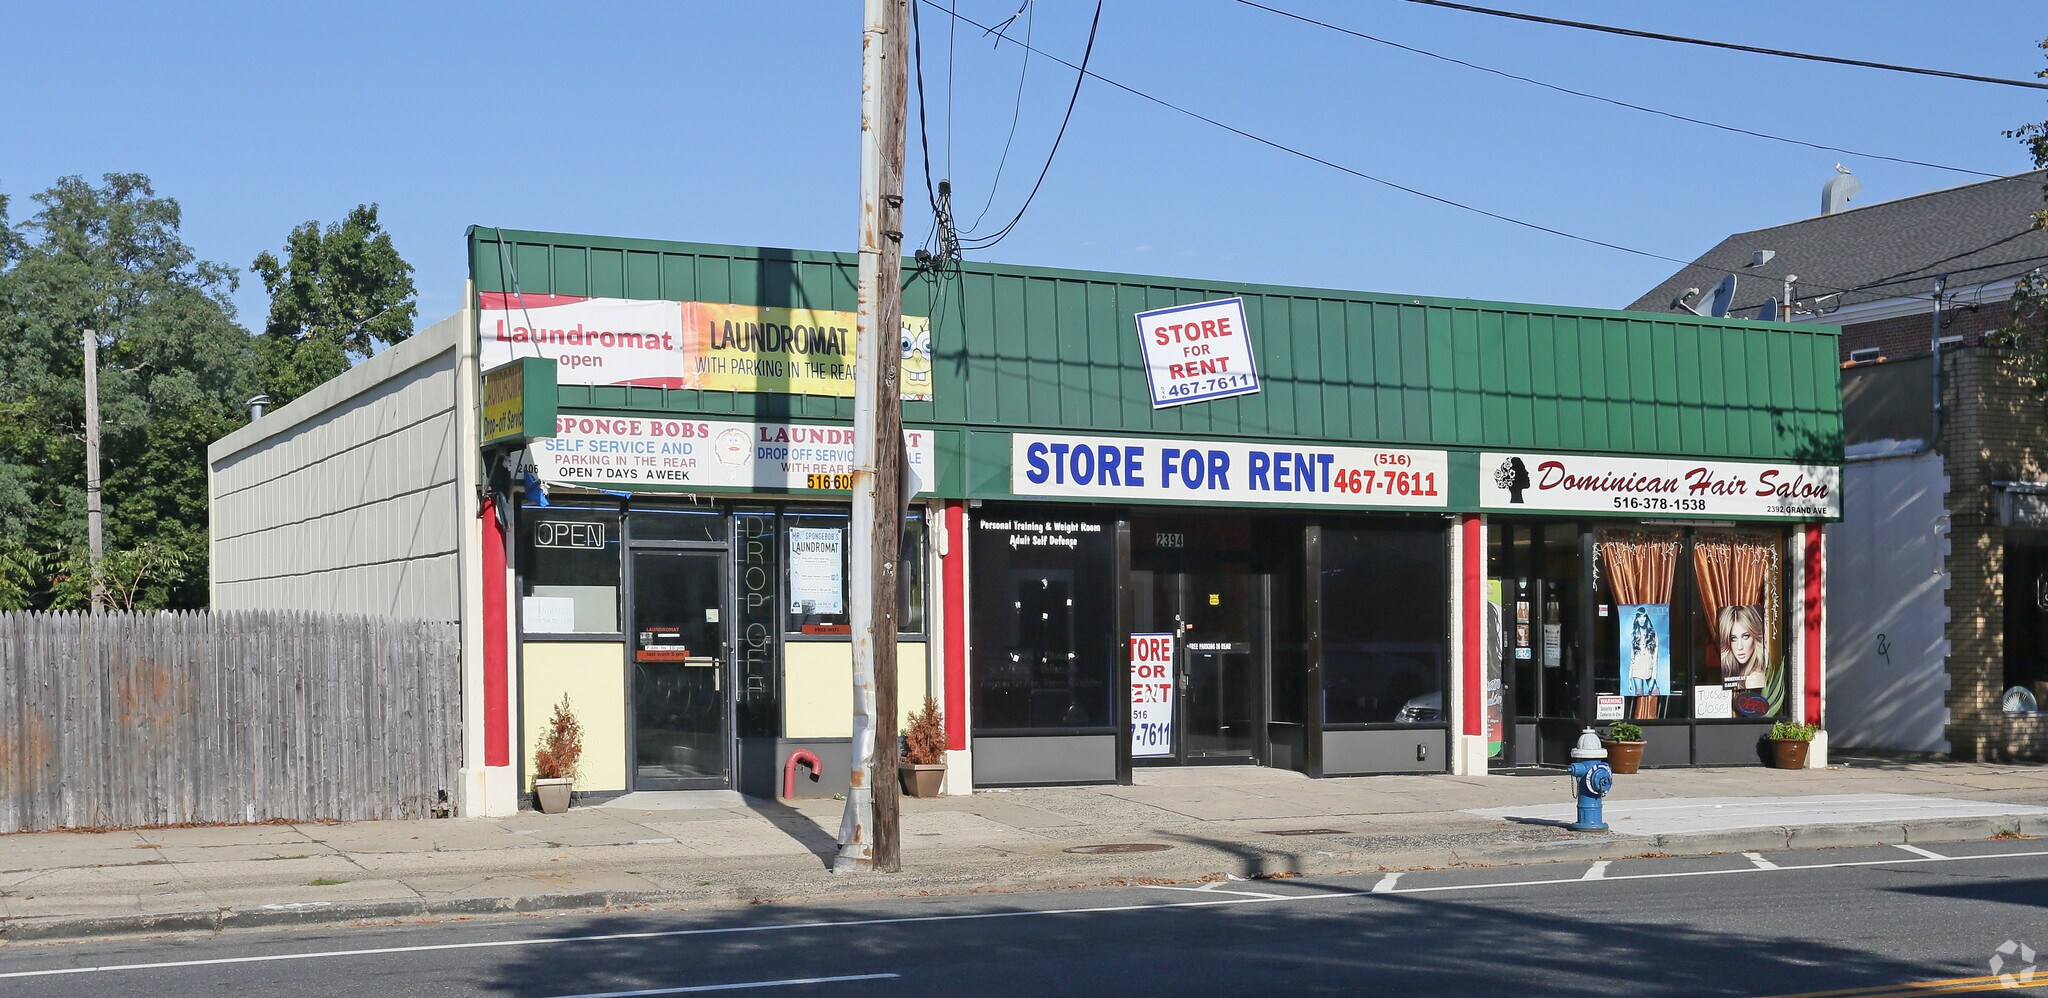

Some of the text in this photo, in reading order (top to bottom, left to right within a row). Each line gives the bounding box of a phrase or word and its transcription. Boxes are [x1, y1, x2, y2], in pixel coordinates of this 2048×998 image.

[496, 319, 673, 351] Laundromat
[710, 320, 848, 357] LAUNDROMAT
[1154, 317, 1232, 346] STORE
[1183, 344, 1210, 357] FOR
[560, 354, 603, 369] open
[695, 355, 725, 374] WITH
[731, 359, 783, 377] PARKING
[788, 361, 799, 378] IN
[804, 362, 826, 379] THE
[1169, 357, 1230, 380] RENT
[1169, 374, 1250, 397] 467-7611
[649, 421, 709, 439] BOBS
[545, 439, 693, 455] SELF SERVICE AND
[758, 447, 788, 460] DROP
[791, 449, 812, 461] OFF
[555, 455, 696, 468] PARKING IN THE REAR
[781, 462, 809, 473] WITH
[813, 463, 845, 474] REAR
[1026, 442, 1334, 493] STORE FOR RENT
[1374, 454, 1411, 468] (516)
[559, 467, 593, 478] OPEN
[596, 468, 603, 478] 7
[606, 468, 638, 479] DAYS
[1537, 461, 1829, 500] Dominican Hair Salon
[1334, 468, 1437, 496] 467-7611
[1613, 497, 1707, 511] 516-378-1538
[1767, 505, 1827, 515] 2392 GRAND AVE
[980, 519, 1011, 530] Personal
[1013, 520, 1044, 534] Training
[1045, 522, 1052, 531] &
[1053, 521, 1079, 534] Weight
[538, 522, 601, 547] OPEN
[1009, 534, 1078, 546] Adult Self Defense
[1157, 534, 1183, 547] 2394
[792, 542, 838, 555] LAUNDROMAT
[1131, 638, 1170, 662] TORE
[1132, 684, 1171, 703] ENT
[1697, 701, 1729, 716] Closed
[1738, 696, 1767, 714] OPEN
[1133, 710, 1148, 719] 516
